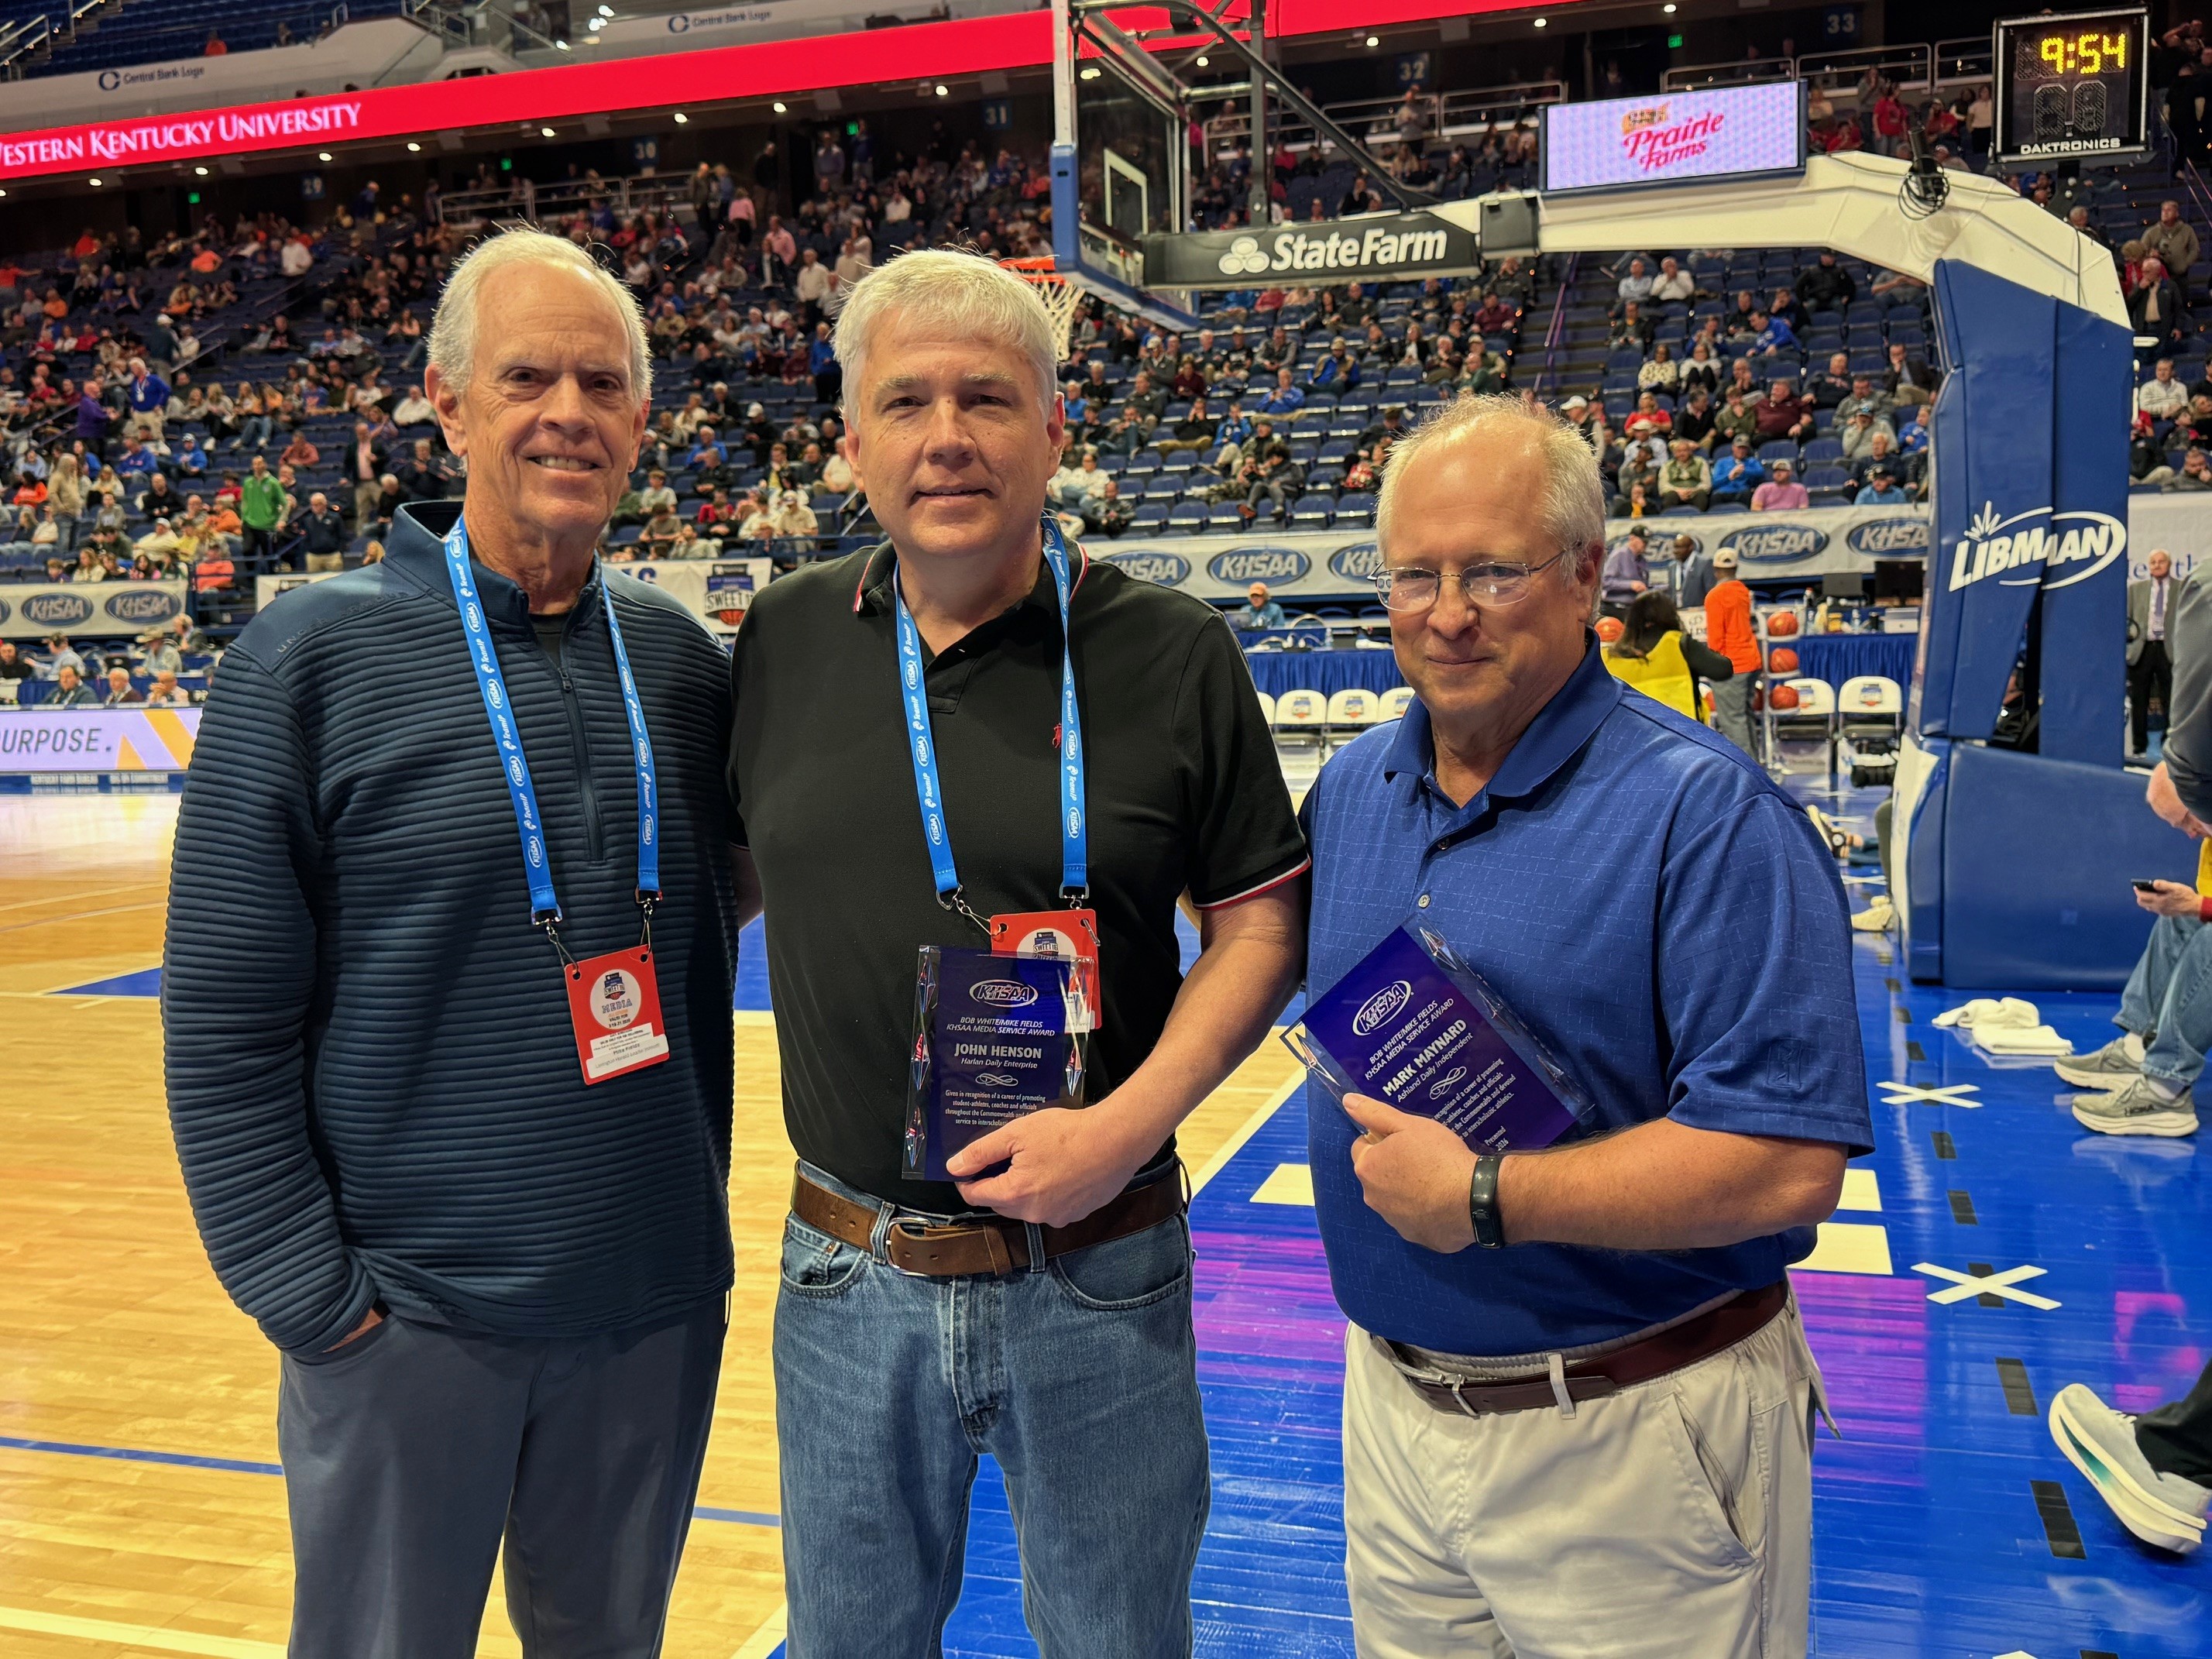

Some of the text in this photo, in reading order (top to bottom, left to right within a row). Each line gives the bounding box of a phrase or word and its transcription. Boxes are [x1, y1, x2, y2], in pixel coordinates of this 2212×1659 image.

[1828, 13, 1854, 33] 33
[2042, 33, 2126, 74] 9:54
[1400, 61, 1424, 81] 32
[986, 106, 1006, 125] 31
[0, 103, 362, 166] ESTERN KENTUCKY UNIVERSITY
[1622, 112, 1725, 159] Prairie
[2021, 137, 2121, 154] DAKTRONICS
[636, 142, 657, 160] 30
[1640, 140, 1707, 171] Farms
[1736, 527, 1815, 558] KHSAA
[1115, 556, 1178, 582] HSAA
[1219, 548, 1299, 579] KHSAA
[1949, 524, 2110, 592] LIBMAN
[30, 598, 84, 620] KHSAA
[116, 594, 171, 618] KHSAA
[1, 728, 112, 753] URPOSE.
[602, 998, 633, 1014] MEDIA
[977, 985, 1030, 1001] KHSAA
[1358, 984, 1406, 1032] KHSAA
[946, 1023, 1055, 1036] KHSAA MEDIA SERVICE AWARD
[1363, 997, 1455, 1080] KHSAA MEDIA SERVICE AWARD
[1368, 1000, 1438, 1064] BOB WHITE/MIKE FIELDS
[954, 1043, 1042, 1059] JOHN HENSON
[961, 1057, 1038, 1069] Harlan Daily Enterprise
[1381, 1017, 1468, 1097] MARK MAYNARD
[1394, 1031, 1474, 1103] Ashland Daily Independent
[1463, 1080, 1478, 1094] career
[1479, 1056, 1504, 1080] promoting
[1022, 1094, 1046, 1103] promoting
[1462, 1091, 1480, 1108] coaches
[1477, 1084, 1488, 1094] and
[1484, 1070, 1503, 1087] officials
[1453, 1120, 1463, 1130] the
[1459, 1094, 1493, 1124] Commonwealth
[1489, 1087, 1501, 1098] and
[1483, 1125, 1506, 1146] Presented
